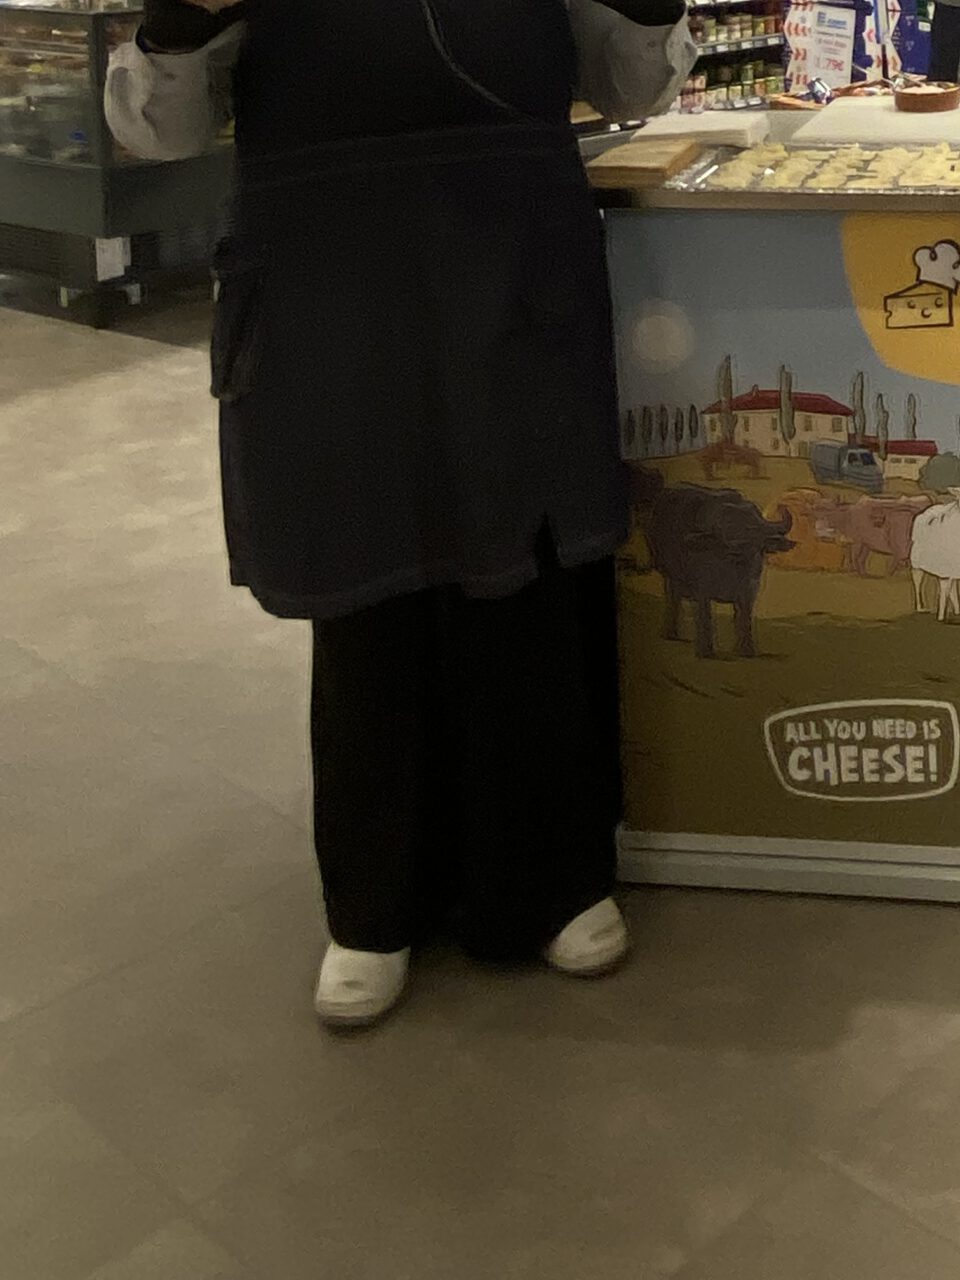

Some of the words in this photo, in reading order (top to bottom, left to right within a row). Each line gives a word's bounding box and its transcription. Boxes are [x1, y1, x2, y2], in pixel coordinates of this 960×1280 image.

[785, 721, 822, 743] ALL
[824, 718, 866, 740] YOU
[872, 718, 916, 739] NEED
[923, 719, 941, 739] IS
[788, 743, 938, 786] CHEESE!
